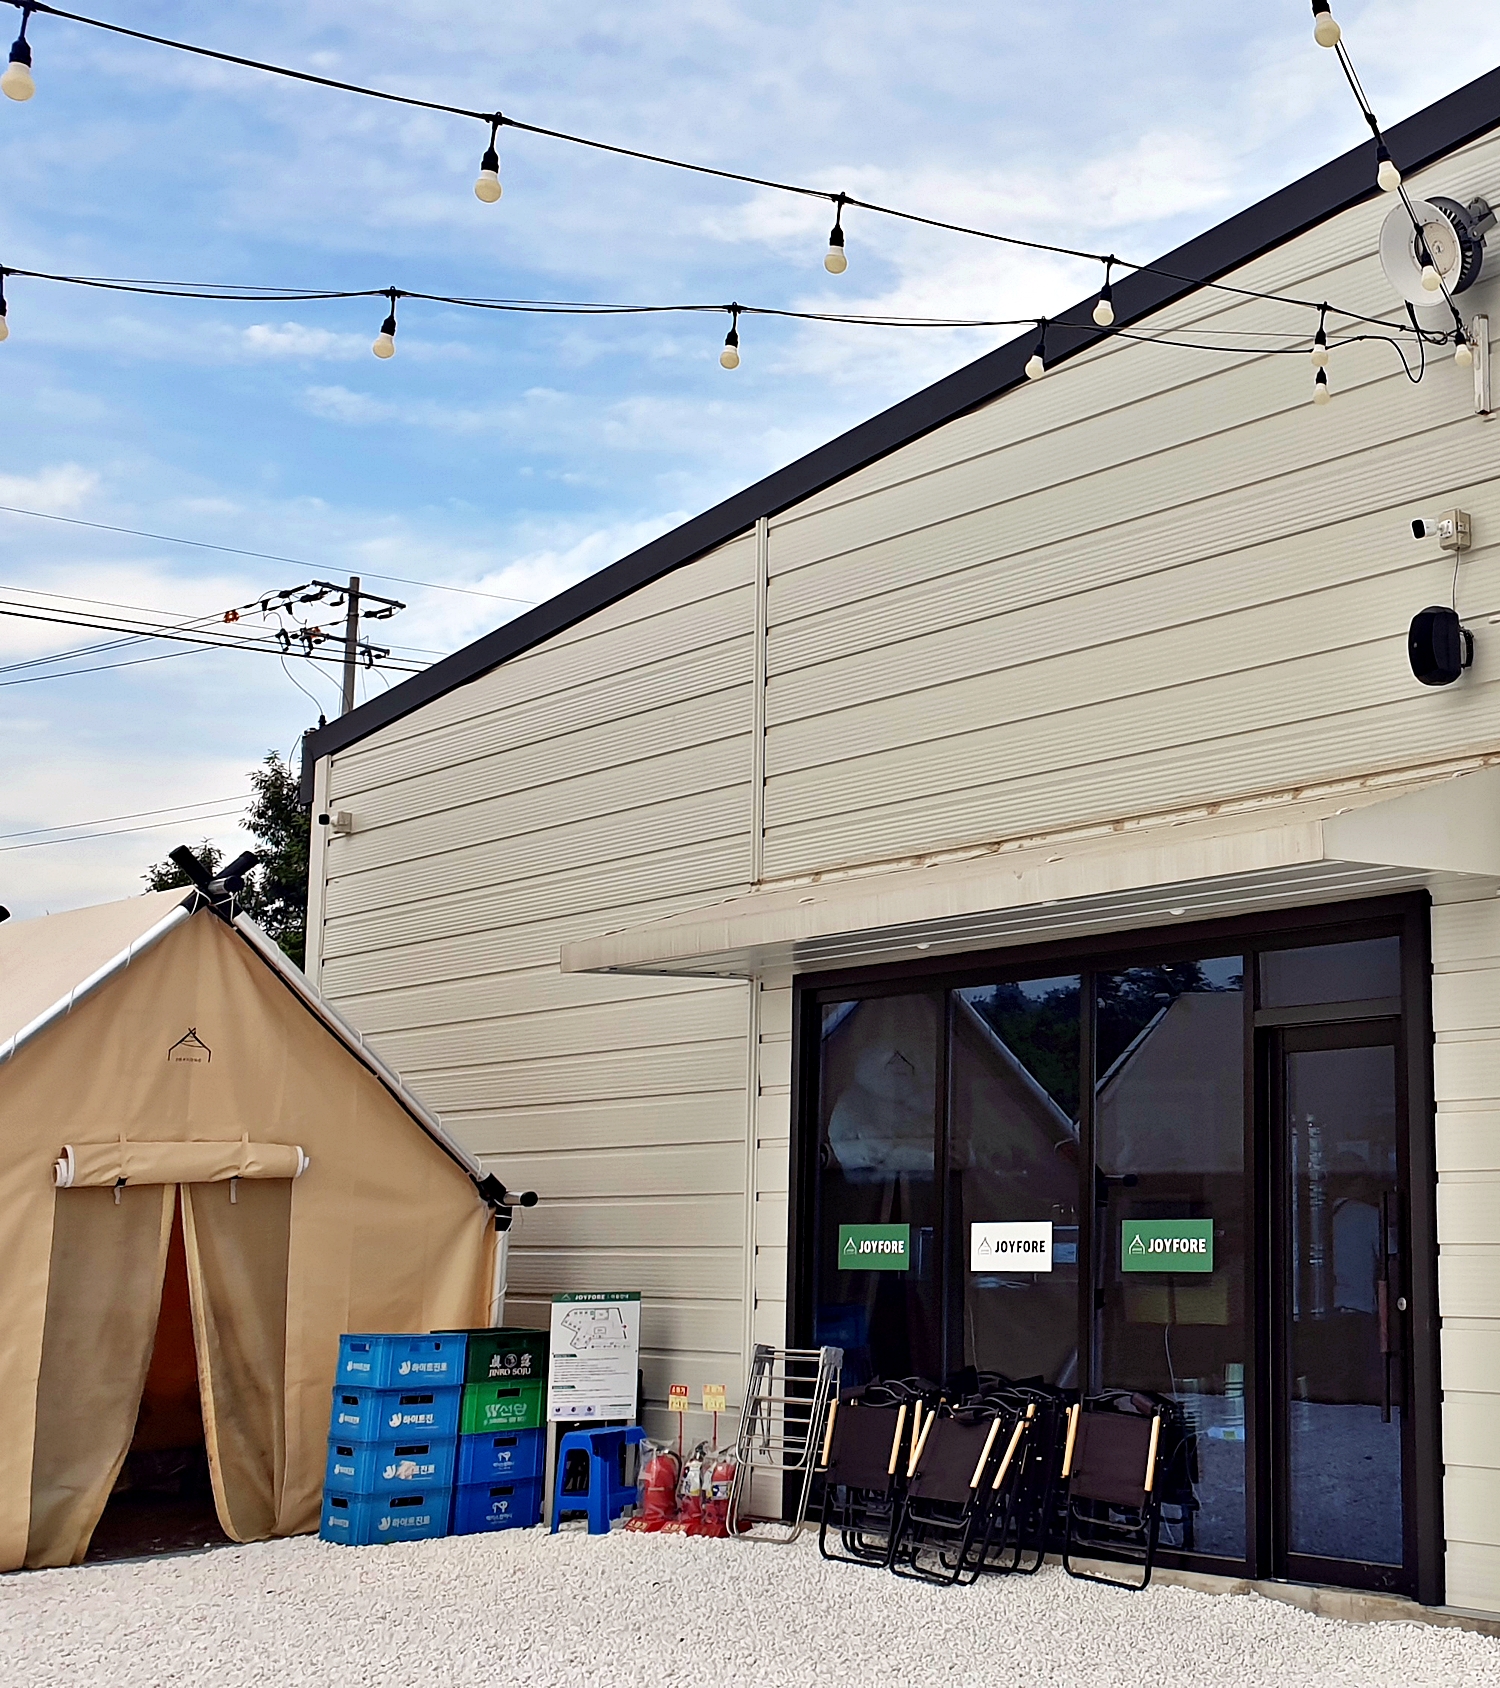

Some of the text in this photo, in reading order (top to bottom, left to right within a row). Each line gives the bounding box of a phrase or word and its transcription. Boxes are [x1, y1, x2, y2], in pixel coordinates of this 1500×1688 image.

[858, 1239, 905, 1254] JOYFORE
[994, 1240, 1046, 1253] JOYFORE
[1147, 1237, 1207, 1254] JOYFORE
